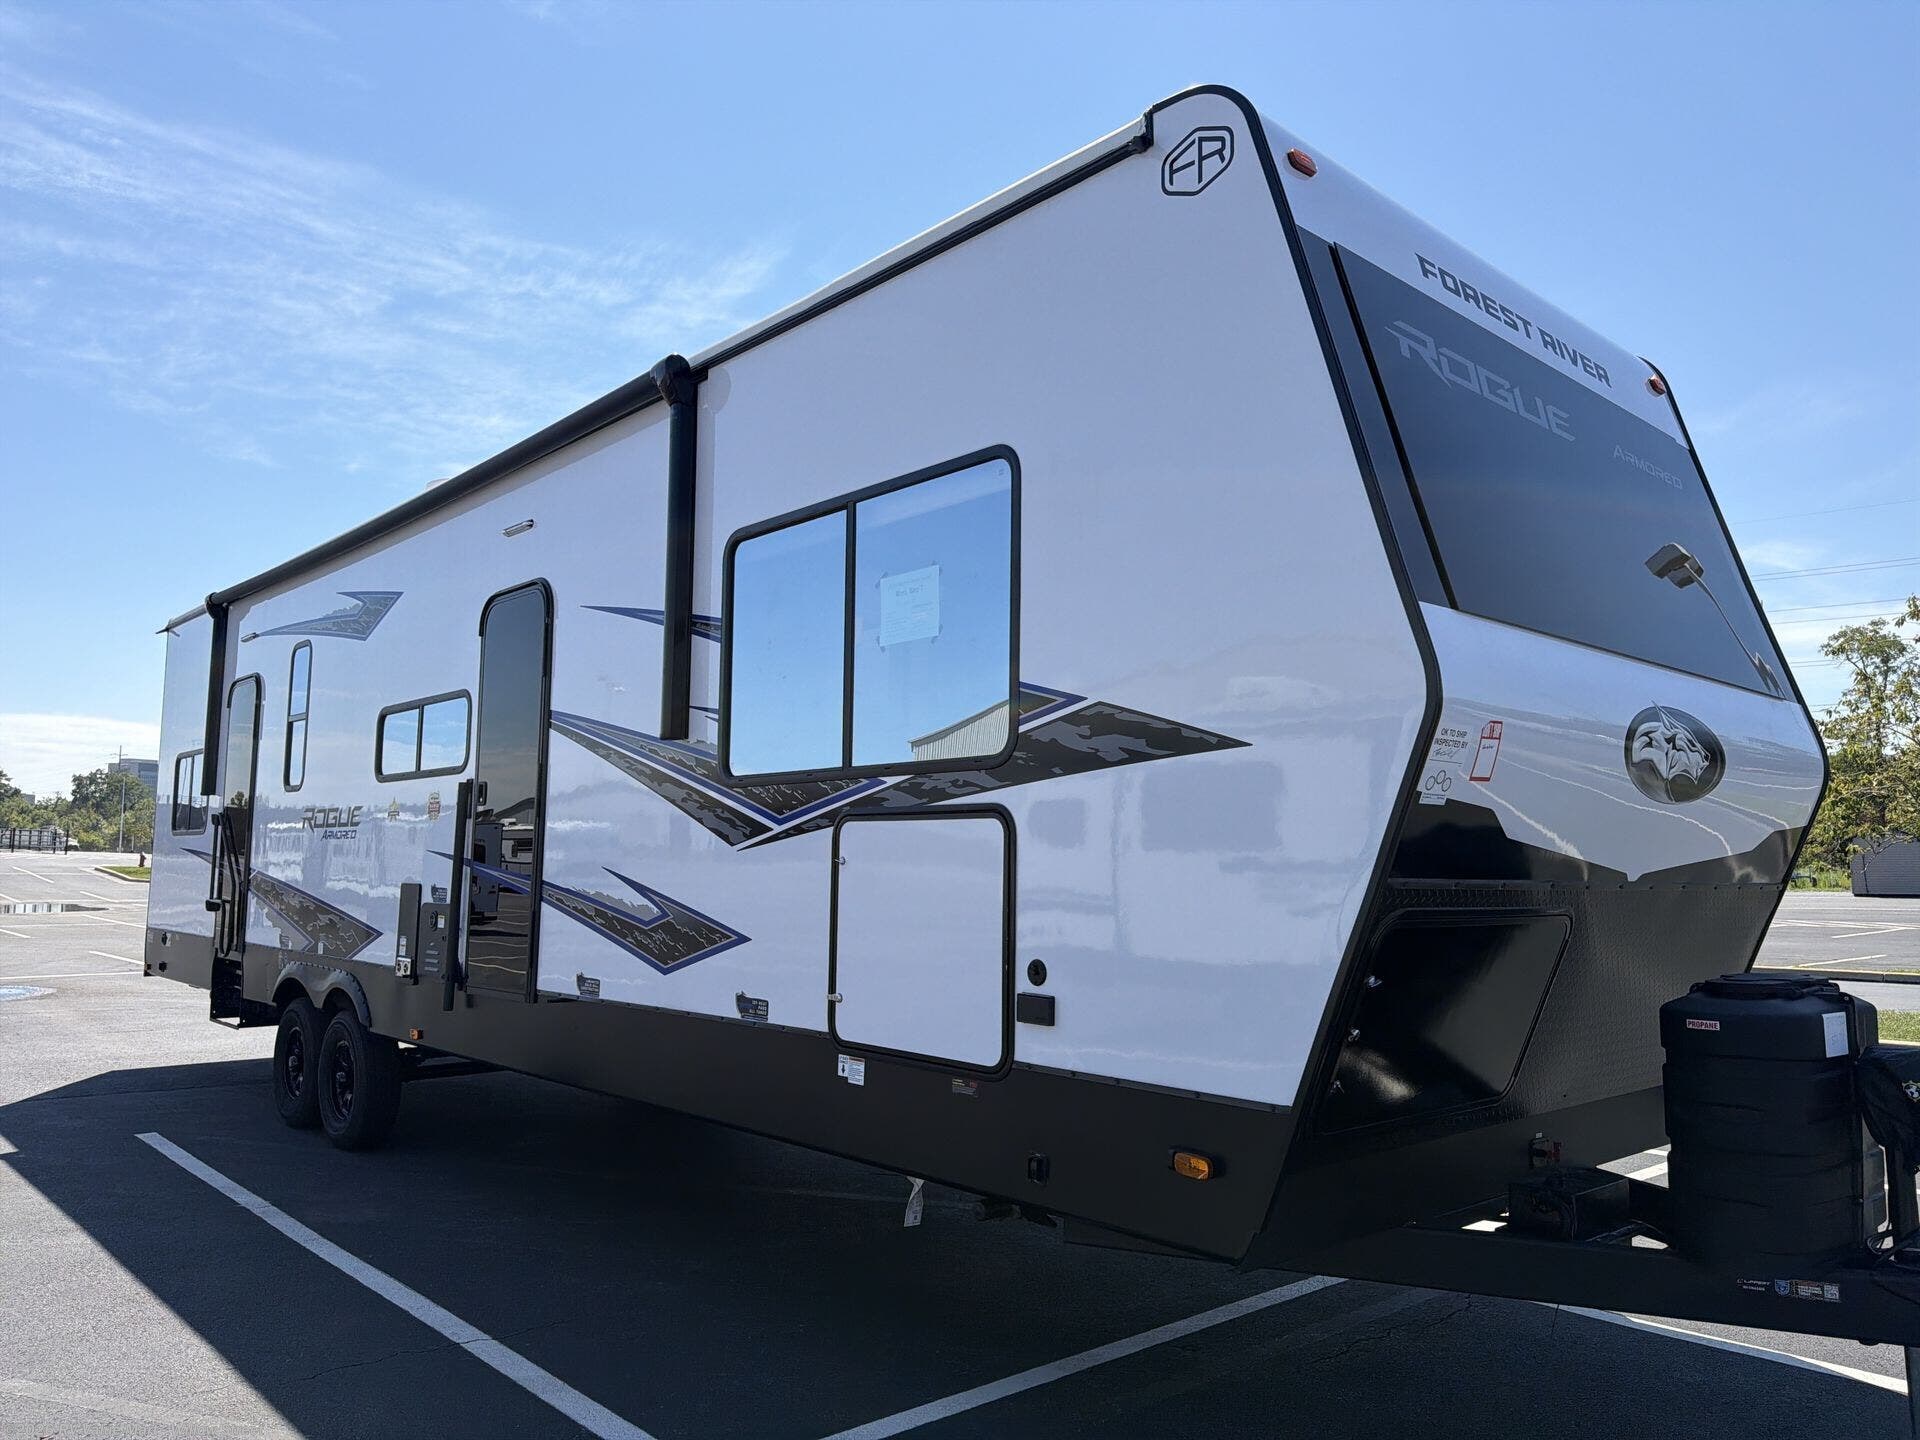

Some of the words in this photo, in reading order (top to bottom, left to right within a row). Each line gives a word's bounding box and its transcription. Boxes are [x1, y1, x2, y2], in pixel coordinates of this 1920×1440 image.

[1167, 135, 1228, 187] FR
[1414, 252, 1532, 340] FOREST
[1536, 325, 1613, 388] RIVER
[1384, 320, 1575, 442] ROGUE
[1612, 444, 1684, 490] ARMORED
[1433, 737, 1461, 749] INSPECTED
[1460, 741, 1468, 749] BY
[1441, 728, 1449, 736] OK
[1449, 729, 1457, 738] TO
[1456, 730, 1468, 739] SHIP
[300, 805, 364, 833] ROGUE
[320, 829, 358, 841] ARMORED
[1687, 1020, 1719, 1030] PROPANE
